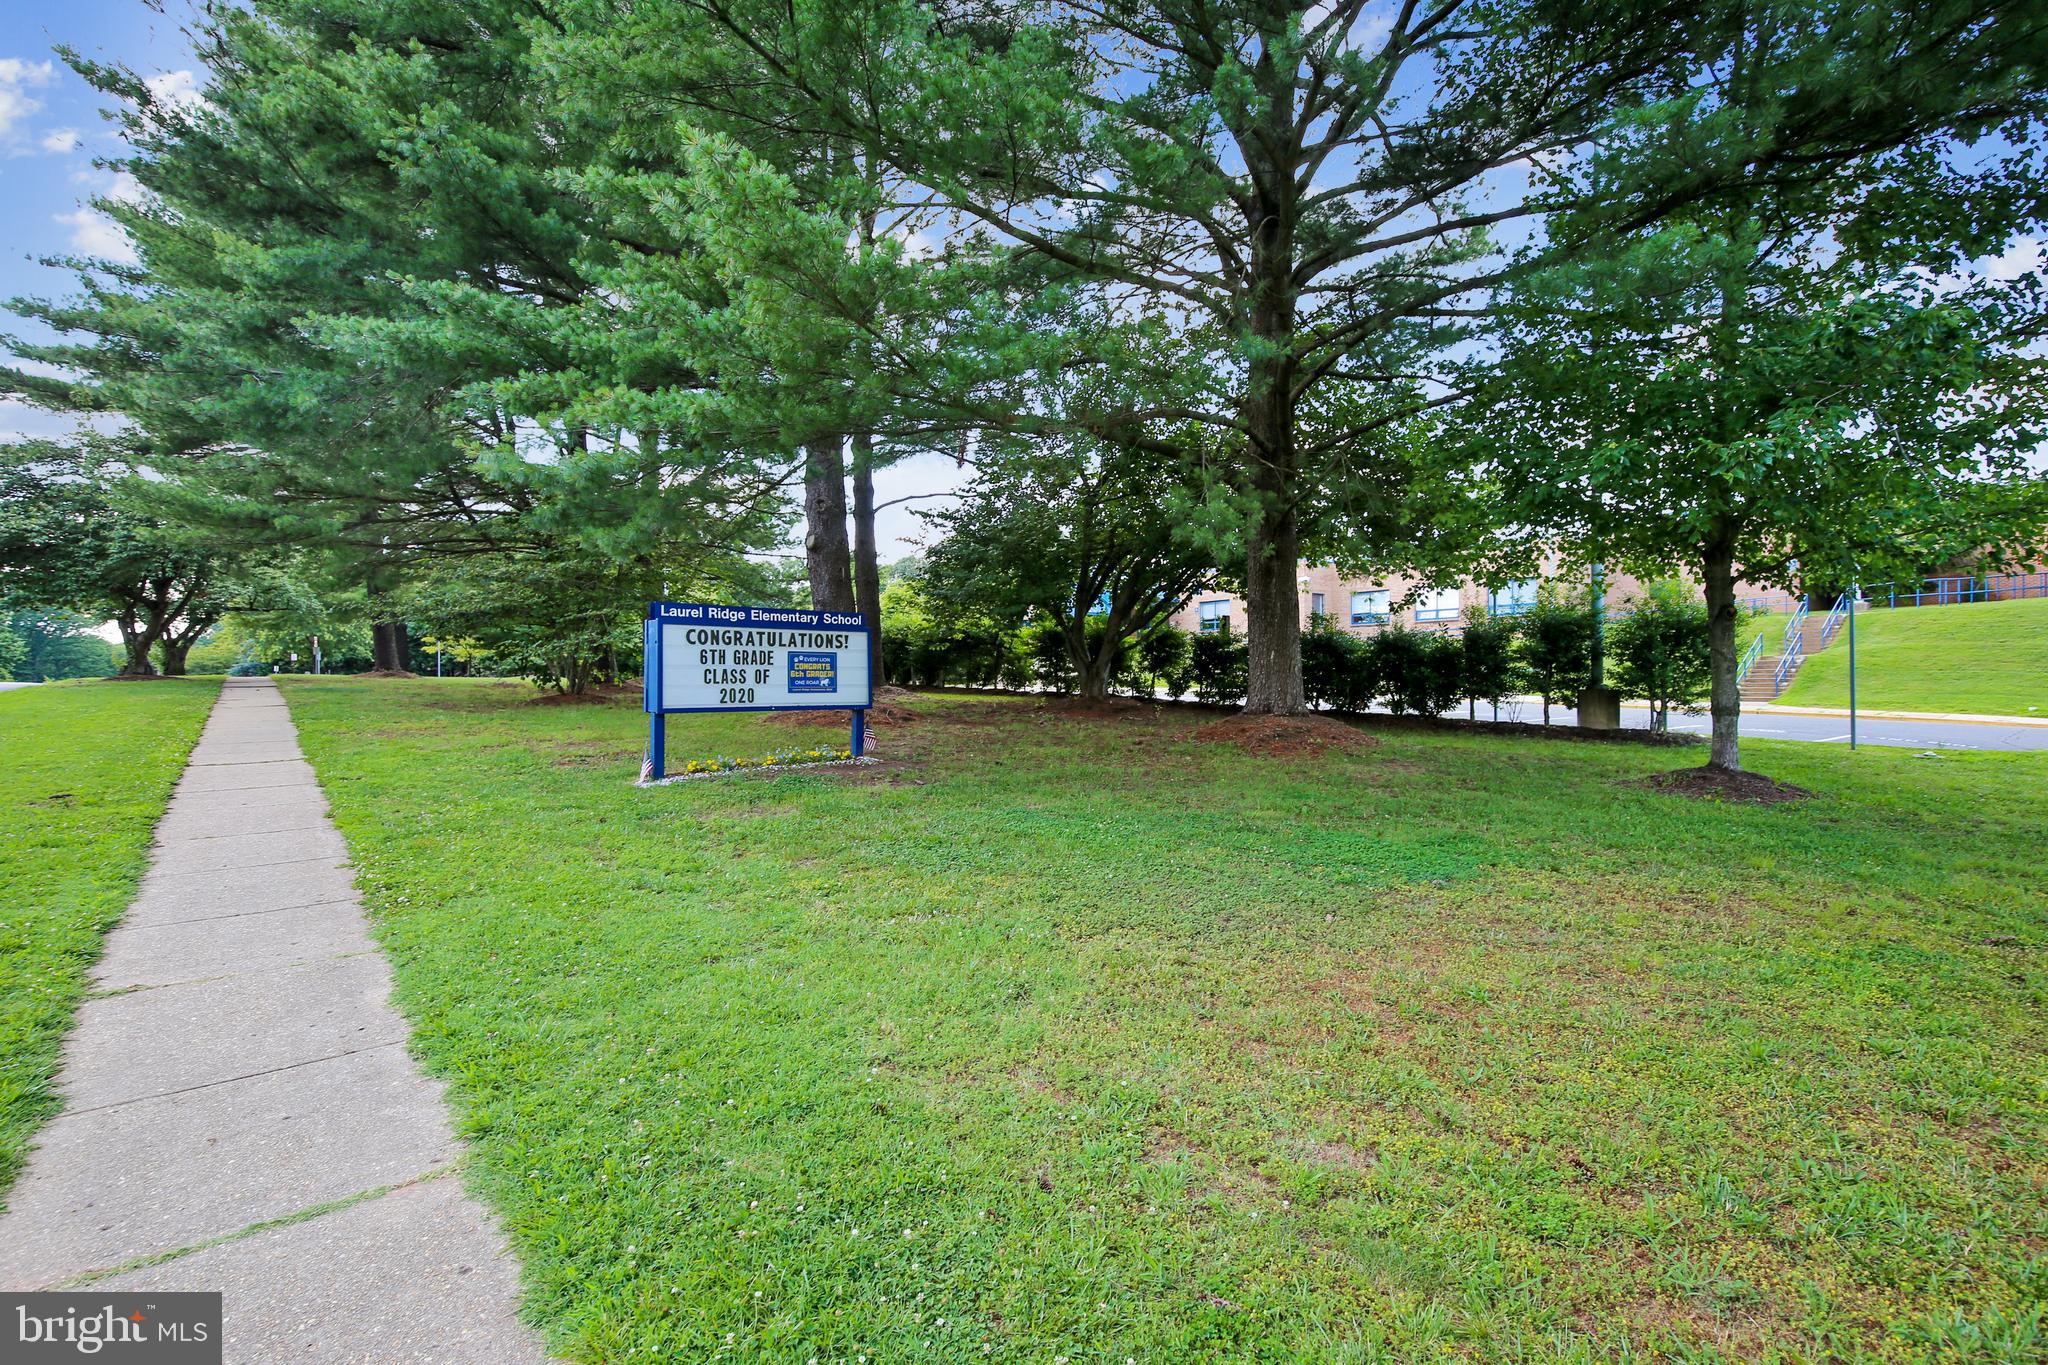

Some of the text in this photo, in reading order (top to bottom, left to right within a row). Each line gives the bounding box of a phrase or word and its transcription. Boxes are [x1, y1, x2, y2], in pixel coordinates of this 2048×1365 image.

[660, 604, 862, 625] Laurel Ridge Elementary School
[685, 628, 849, 649] CONGRATULATIONS!
[700, 649, 774, 666] 6TH GRADE
[703, 668, 770, 684] CLASS OF
[719, 687, 754, 704] 2020
